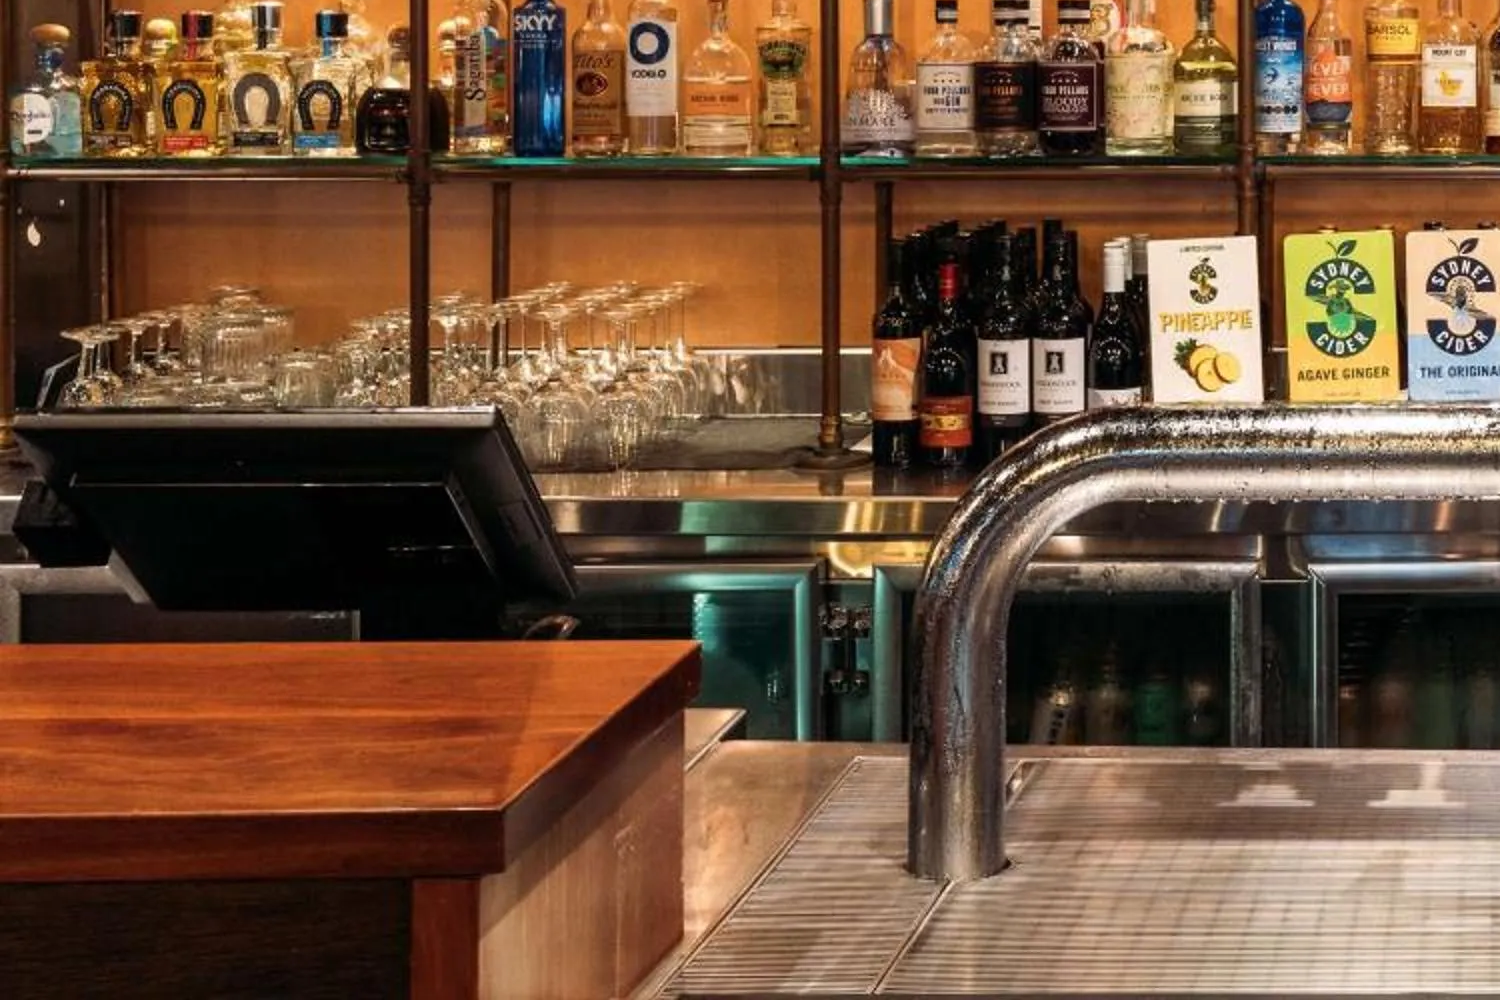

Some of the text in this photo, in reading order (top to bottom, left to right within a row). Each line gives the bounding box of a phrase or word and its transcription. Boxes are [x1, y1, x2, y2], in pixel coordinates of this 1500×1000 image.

[514, 14, 557, 31] SKYY
[1311, 261, 1370, 289] SYDNEY
[1431, 259, 1491, 287] SYDNEY
[1158, 309, 1253, 333] PINEAPPLE
[1316, 331, 1369, 355] CIDER
[1436, 330, 1489, 353] CIDER
[1297, 365, 1390, 382] AGAVE GINGER
[1420, 366, 1443, 379] THE
